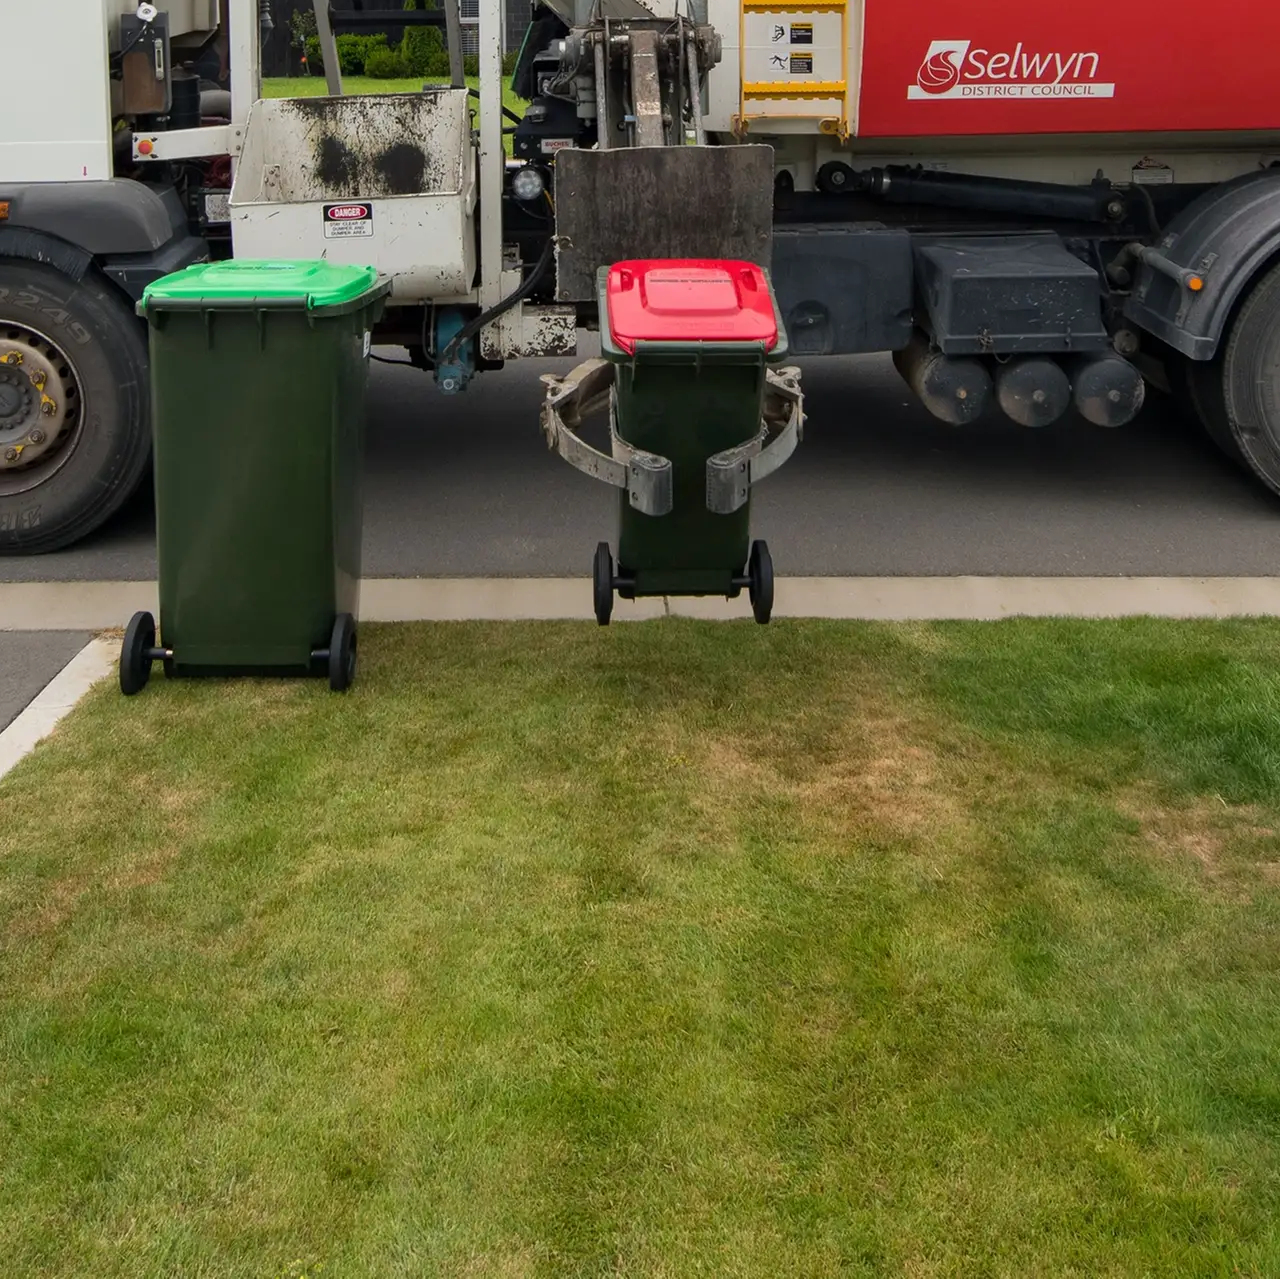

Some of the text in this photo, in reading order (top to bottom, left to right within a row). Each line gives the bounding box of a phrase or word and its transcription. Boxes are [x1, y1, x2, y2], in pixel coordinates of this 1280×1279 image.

[963, 42, 1099, 86] Selwyn
[962, 85, 1095, 96] DISTRICT COUNCIL
[334, 207, 361, 218] DANGER
